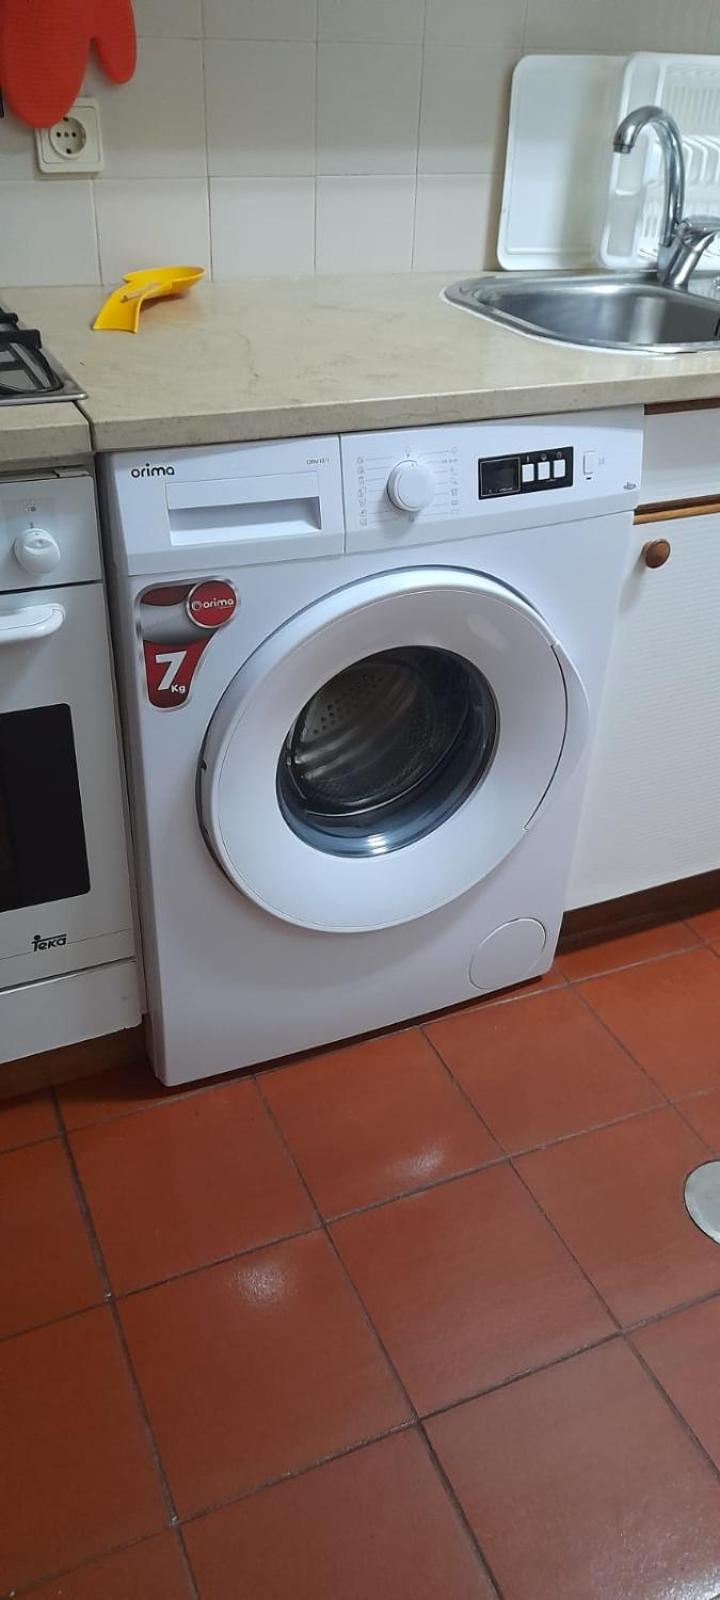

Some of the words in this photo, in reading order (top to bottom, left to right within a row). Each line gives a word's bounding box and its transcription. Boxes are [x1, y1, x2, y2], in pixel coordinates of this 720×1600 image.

[131, 463, 175, 478] orima
[203, 598, 234, 609] orima
[155, 650, 187, 691] 7
[171, 684, 186, 694] Kg
[31, 933, 67, 952] Teka
